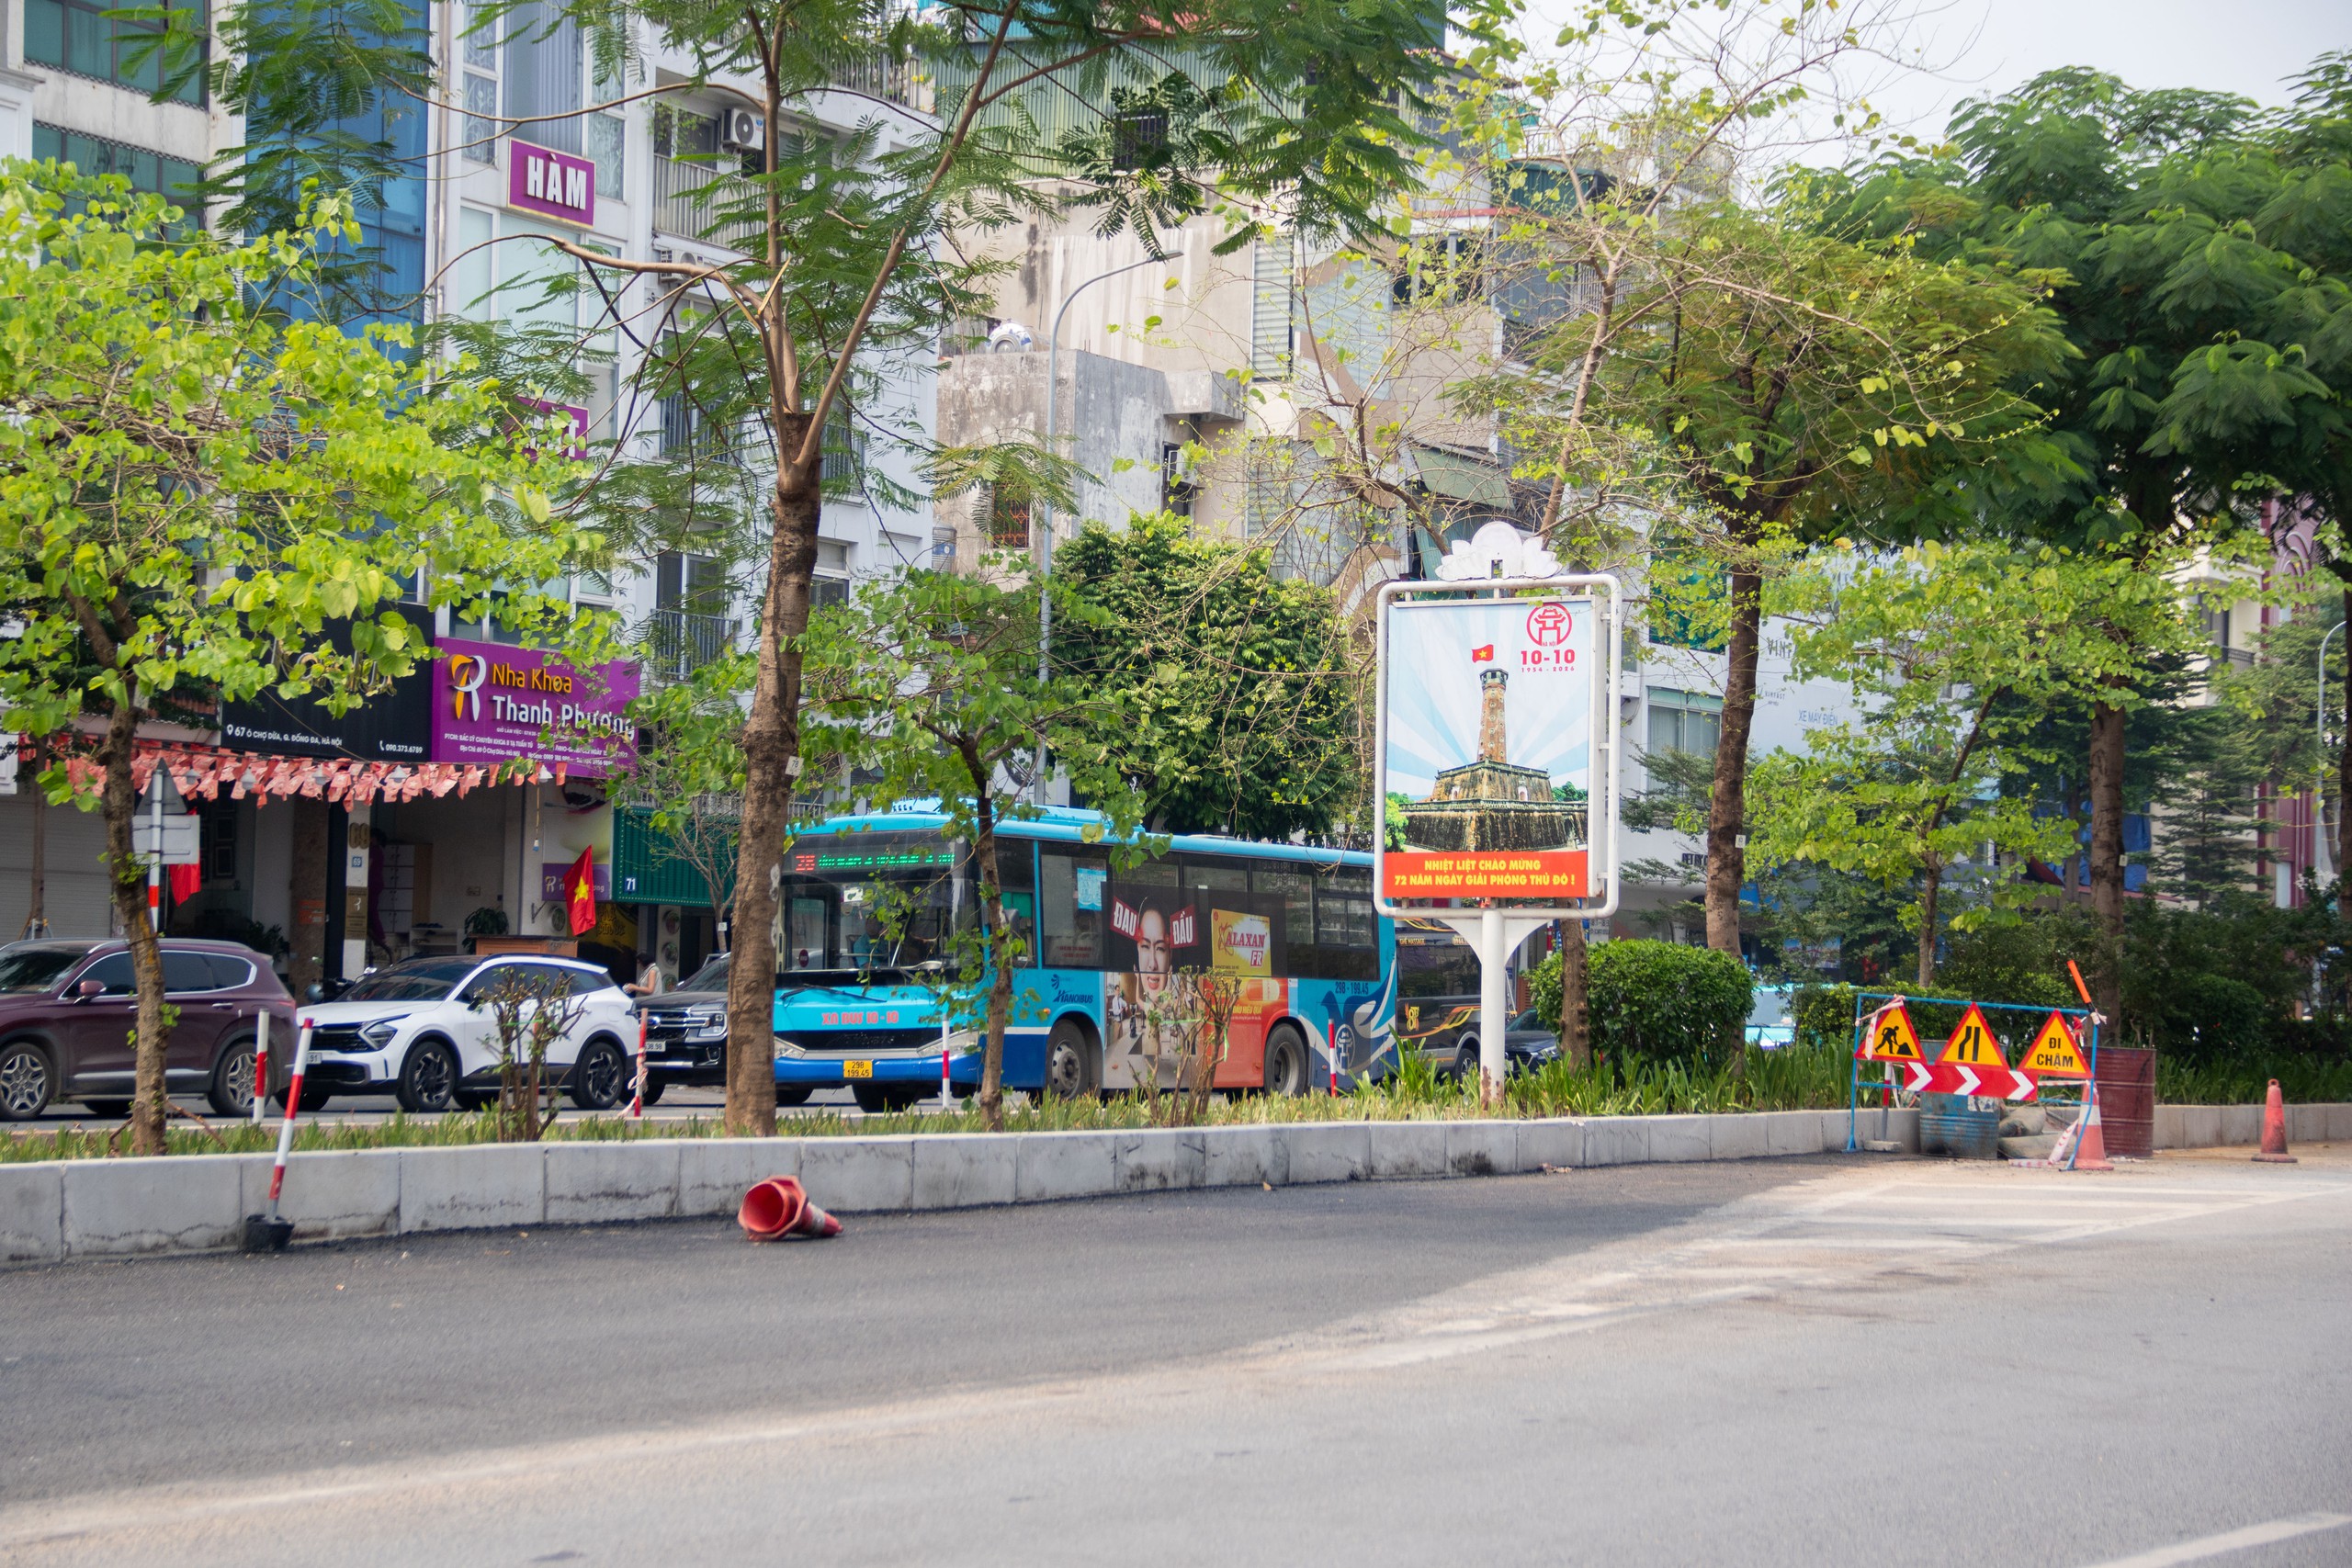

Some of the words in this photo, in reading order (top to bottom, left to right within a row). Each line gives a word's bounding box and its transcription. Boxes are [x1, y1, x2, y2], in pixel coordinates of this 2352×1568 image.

[527, 152, 587, 210] HÀM
[492, 662, 526, 688] Nha
[531, 668, 572, 694] Khoa
[492, 694, 552, 725] Thanh
[1798, 709, 1807, 722] XE
[234, 726, 245, 738] 67
[253, 730, 267, 741] CHỢ
[267, 730, 282, 742] DỪA,
[291, 733, 310, 744] ĐỐNG
[322, 737, 331, 745] HÀ
[331, 738, 343, 747] NỘI
[1425, 858, 1454, 873] NHIỆT
[1456, 858, 1477, 873] LIỆT
[1478, 857, 1507, 871] CHÀO
[1509, 858, 1541, 871] MỪNG
[626, 878, 636, 891] 71
[1395, 875, 1408, 886] 72
[1409, 874, 1432, 886] NĂM
[1435, 874, 1464, 886] NGÀY
[1465, 873, 1487, 886] GIẢI
[1489, 873, 1527, 886] PHÓNG
[1529, 872, 1550, 886] THỦ
[1553, 873, 1568, 886] ĐÔ
[1114, 901, 1137, 937] ĐAU
[1172, 910, 1193, 945] ĐẦU
[1225, 931, 1266, 948] ALAXAN
[1251, 950, 1263, 965] FR
[1335, 981, 1346, 994] 29B
[1351, 983, 1369, 995] 199.45
[1053, 990, 1094, 1003] HANOIBUS
[842, 1012, 864, 1024] BUS
[866, 1011, 878, 1024] 10
[887, 1011, 899, 1024] 10
[2049, 1037, 2061, 1049] ĐI
[852, 1061, 865, 1069] 29B
[2037, 1053, 2074, 1069] CHẬM
[847, 1069, 870, 1077] 199.45
